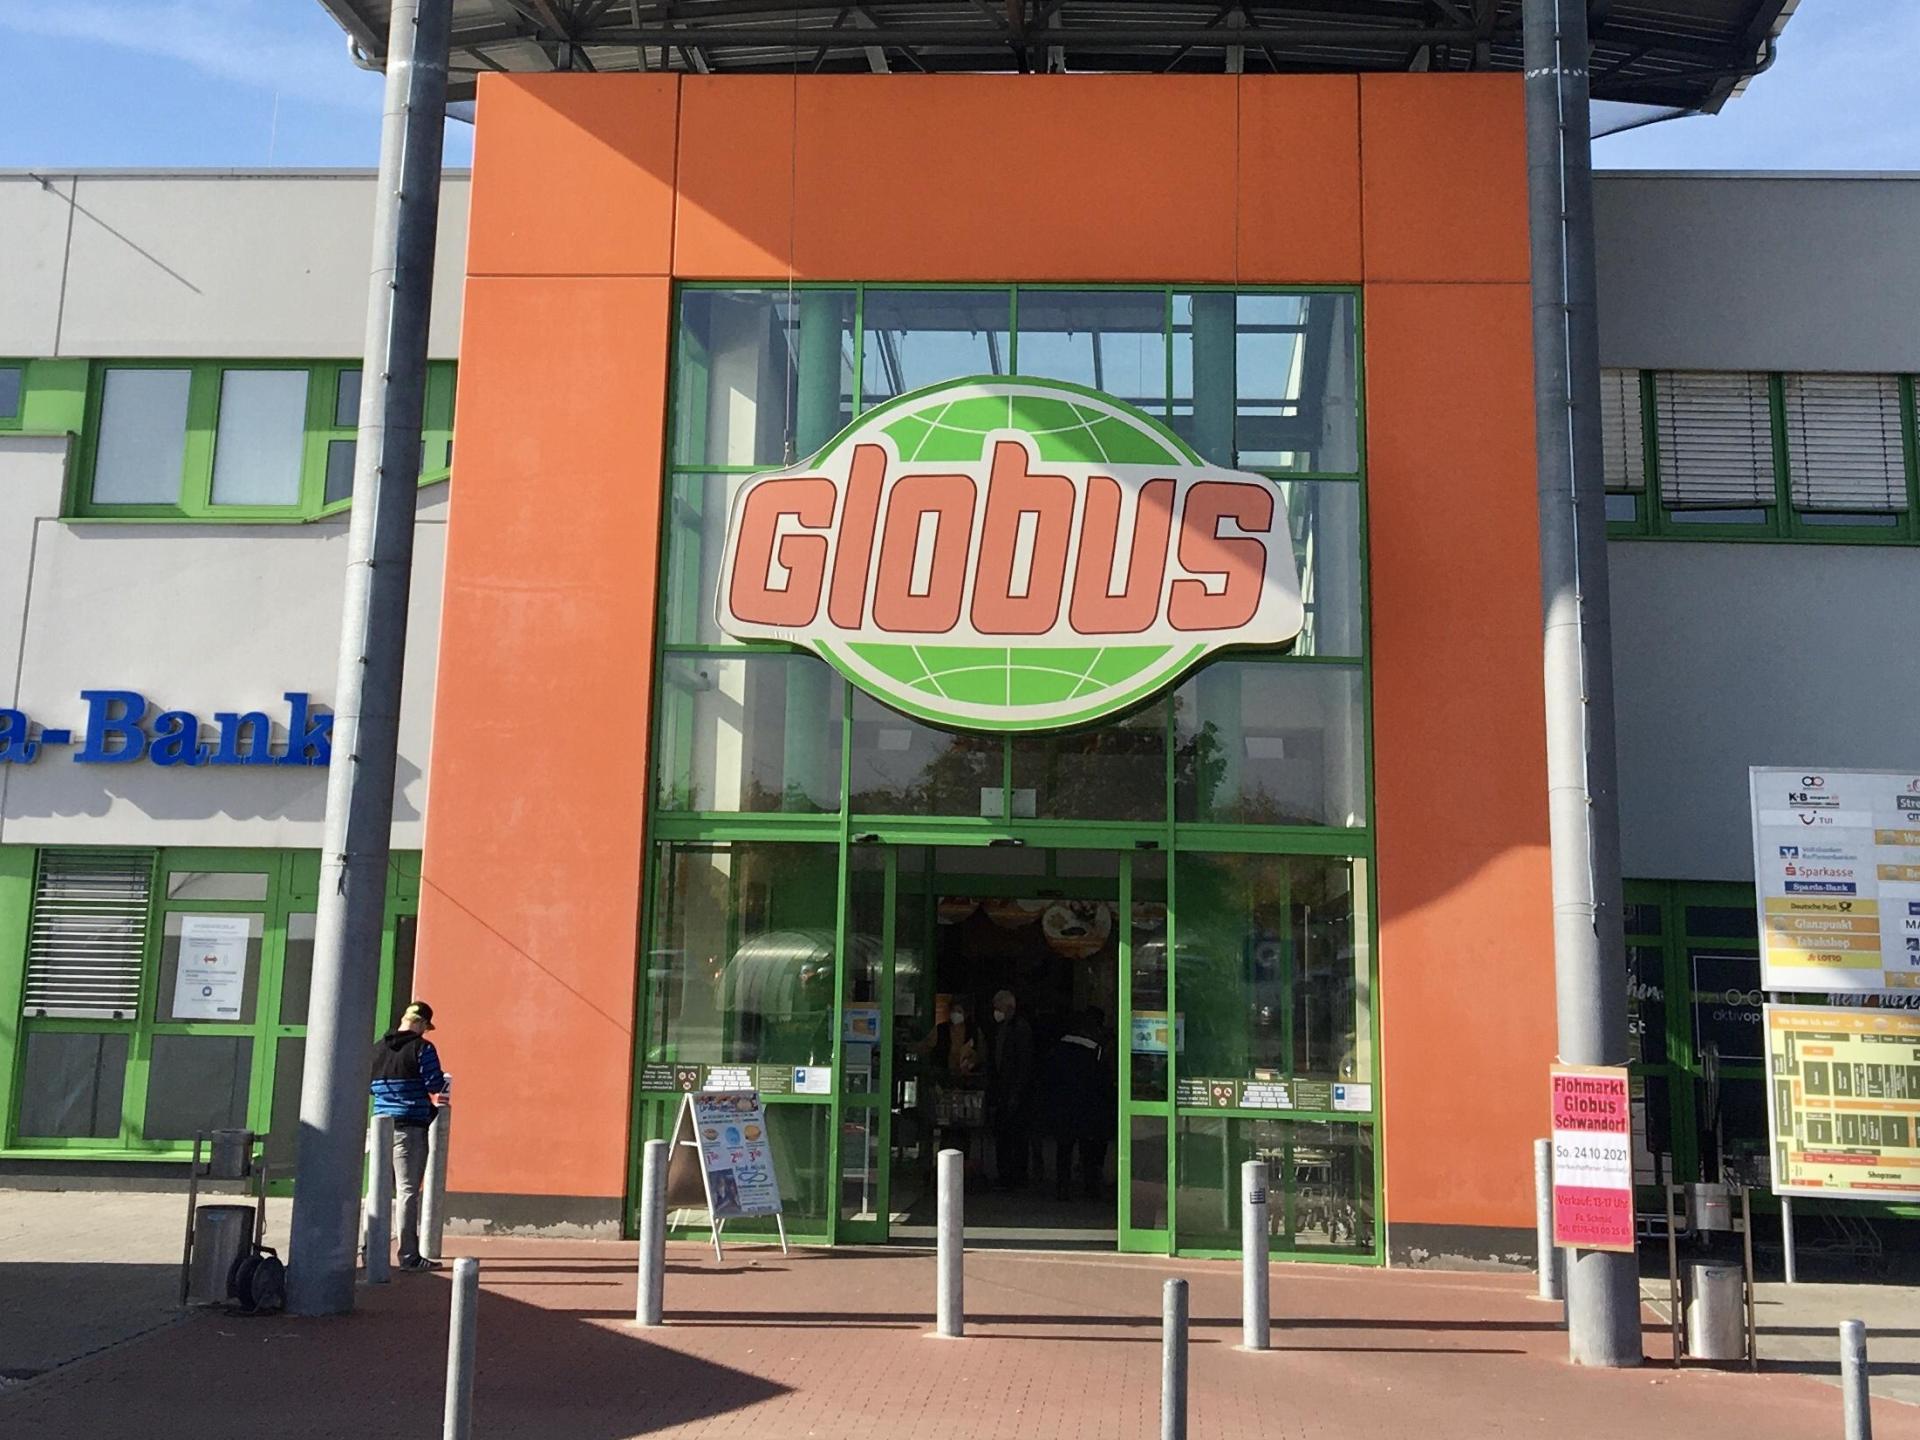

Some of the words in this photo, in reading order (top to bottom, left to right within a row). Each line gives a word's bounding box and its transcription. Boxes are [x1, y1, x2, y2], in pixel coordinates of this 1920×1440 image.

[729, 440, 1274, 636] Globus
[1799, 866, 1853, 878] Sparkasse
[1793, 883, 1848, 892] Sparda-Bank
[1795, 919, 1853, 931] Glanzpunkt
[1817, 954, 1841, 962] LOTTO
[1554, 1077, 1625, 1095] Flohmarkt
[1564, 1096, 1617, 1114] Globus
[1555, 1114, 1626, 1132] Schwandorf
[1556, 1146, 1572, 1158] So.
[1575, 1147, 1627, 1161] 24.10.2021
[1557, 1195, 1592, 1207] Verkauf:
[1614, 1199, 1629, 1209] Uhr
